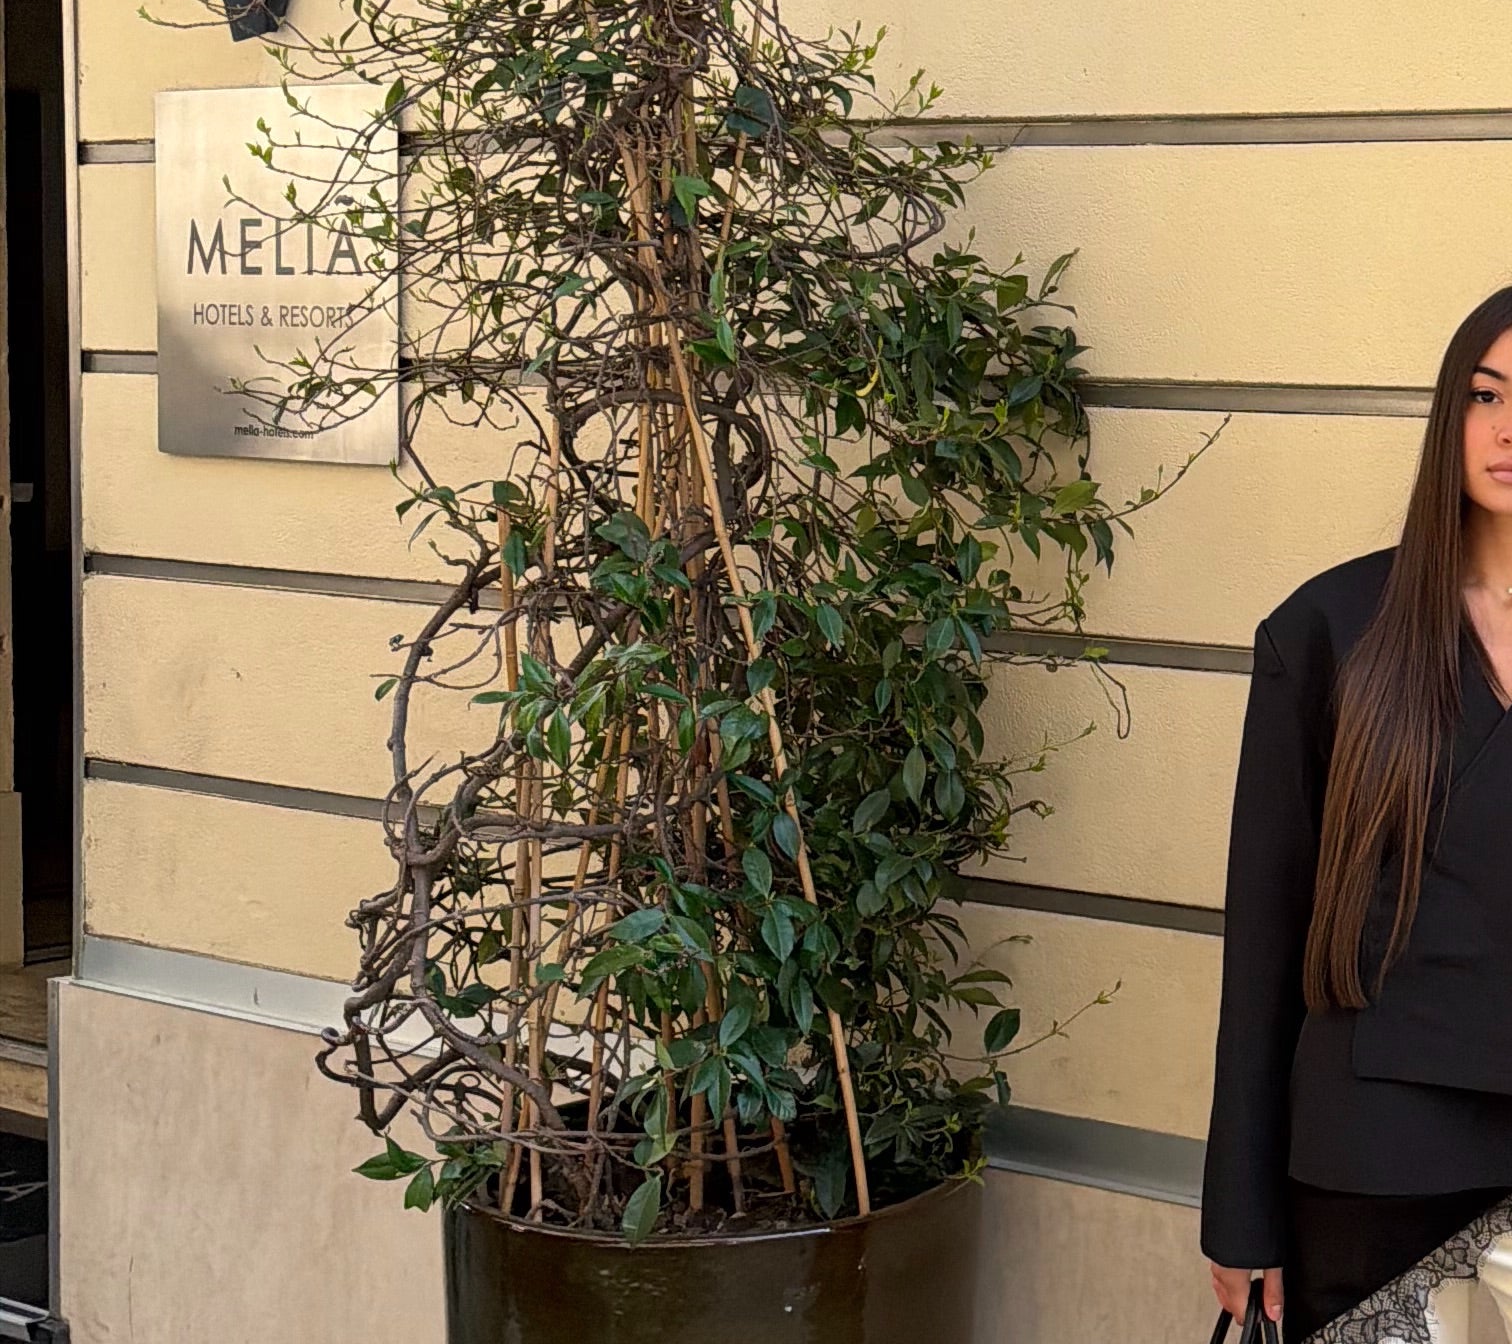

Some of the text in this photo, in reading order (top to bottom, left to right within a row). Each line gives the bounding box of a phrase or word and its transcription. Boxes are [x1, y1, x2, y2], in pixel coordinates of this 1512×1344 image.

[193, 303, 354, 329] HOTELS & RESORTS
